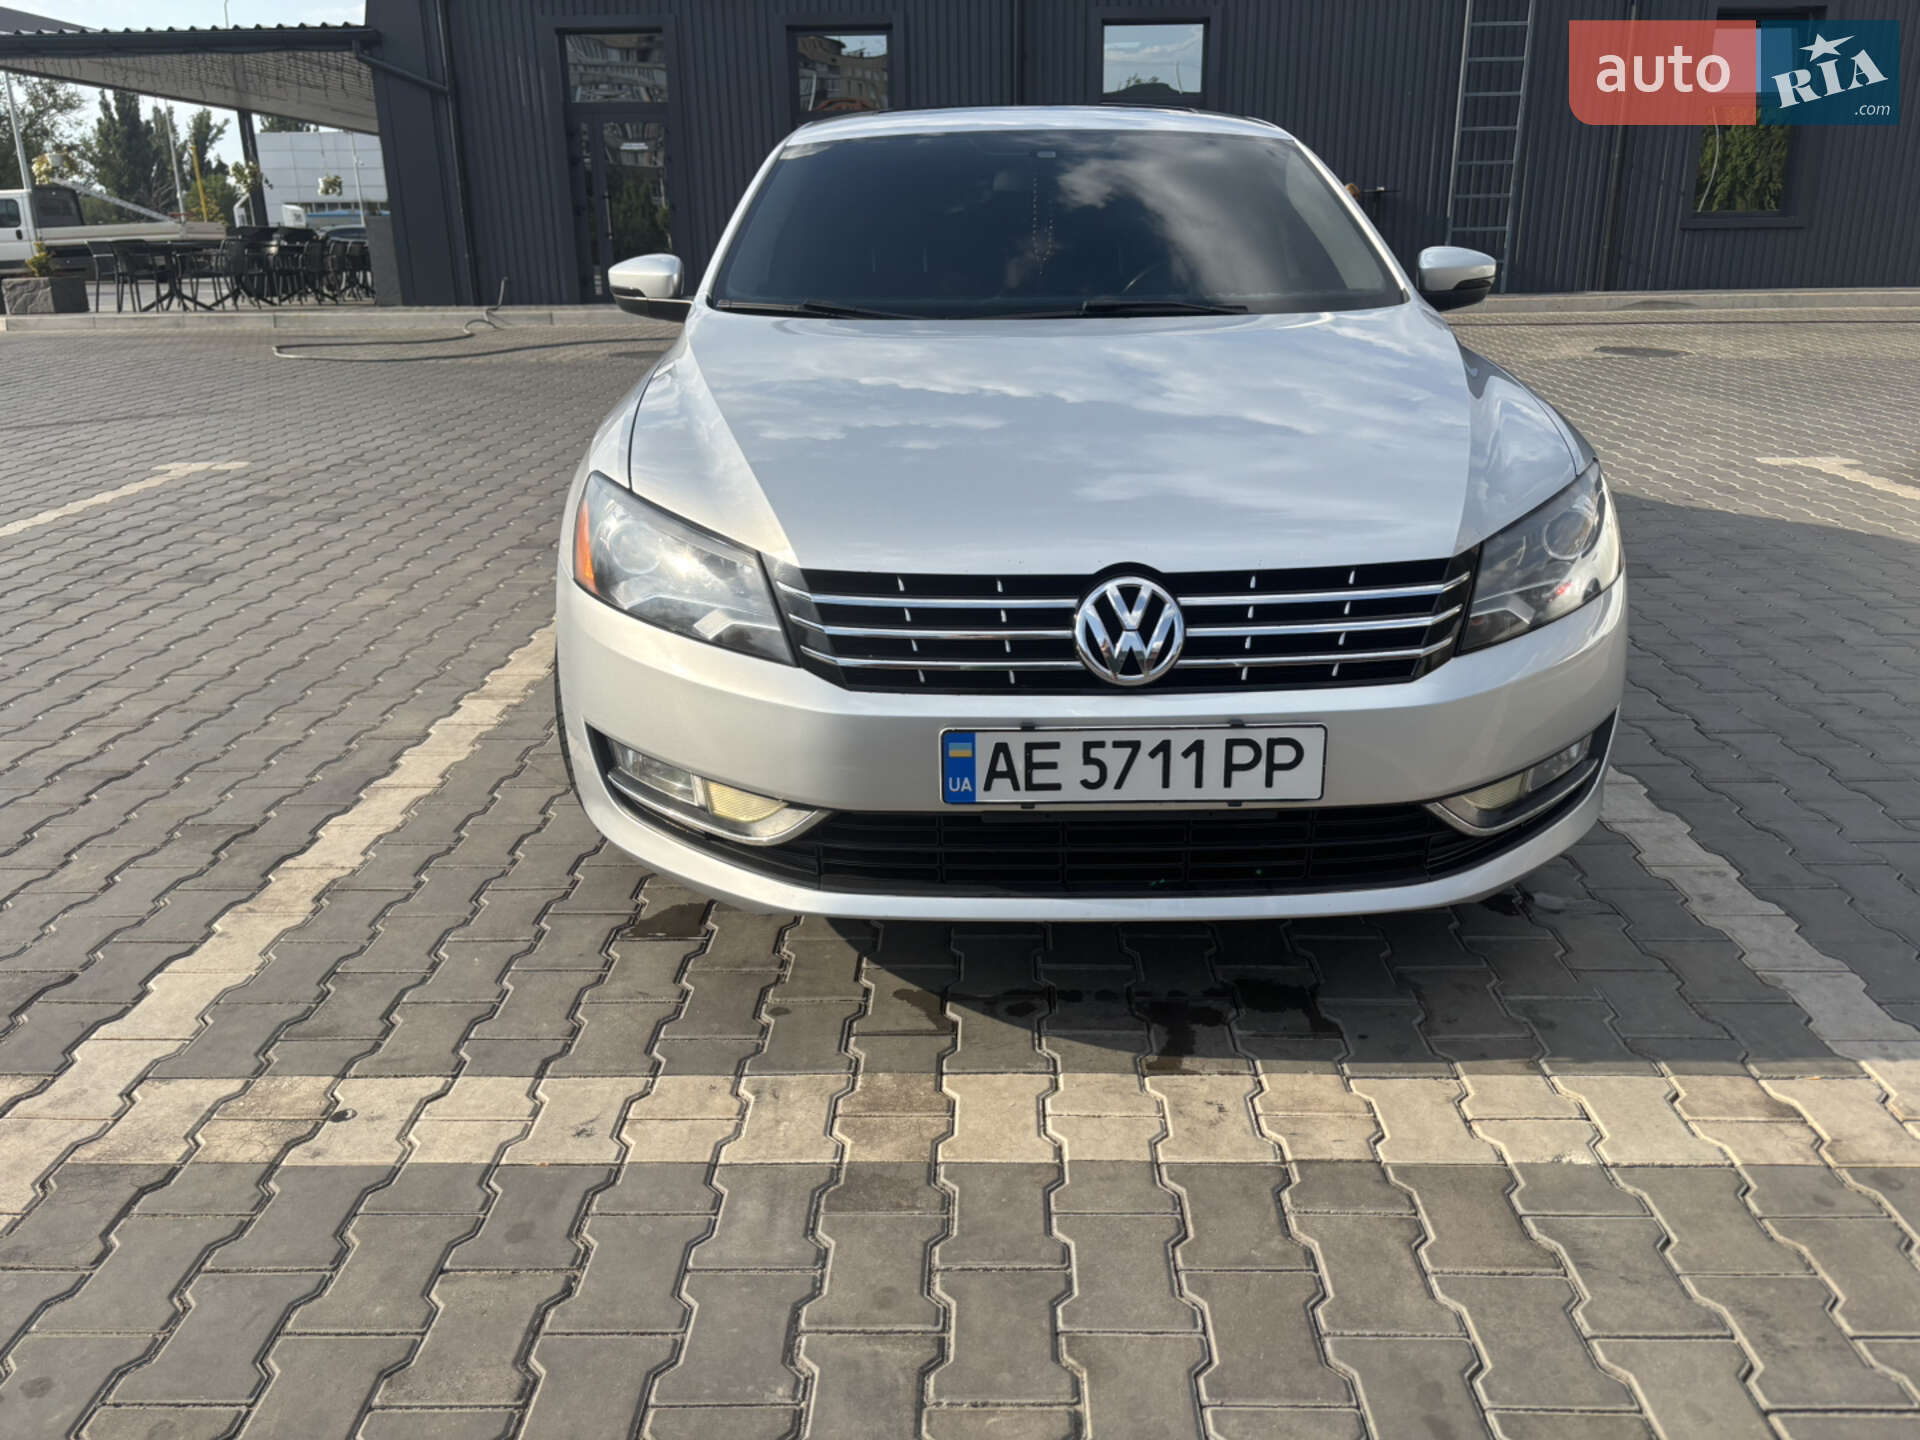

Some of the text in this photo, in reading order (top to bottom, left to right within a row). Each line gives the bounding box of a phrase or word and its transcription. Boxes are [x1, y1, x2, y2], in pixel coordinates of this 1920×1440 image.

[983, 737, 1305, 791] AE 5711 PP
[948, 777, 973, 793] UA
